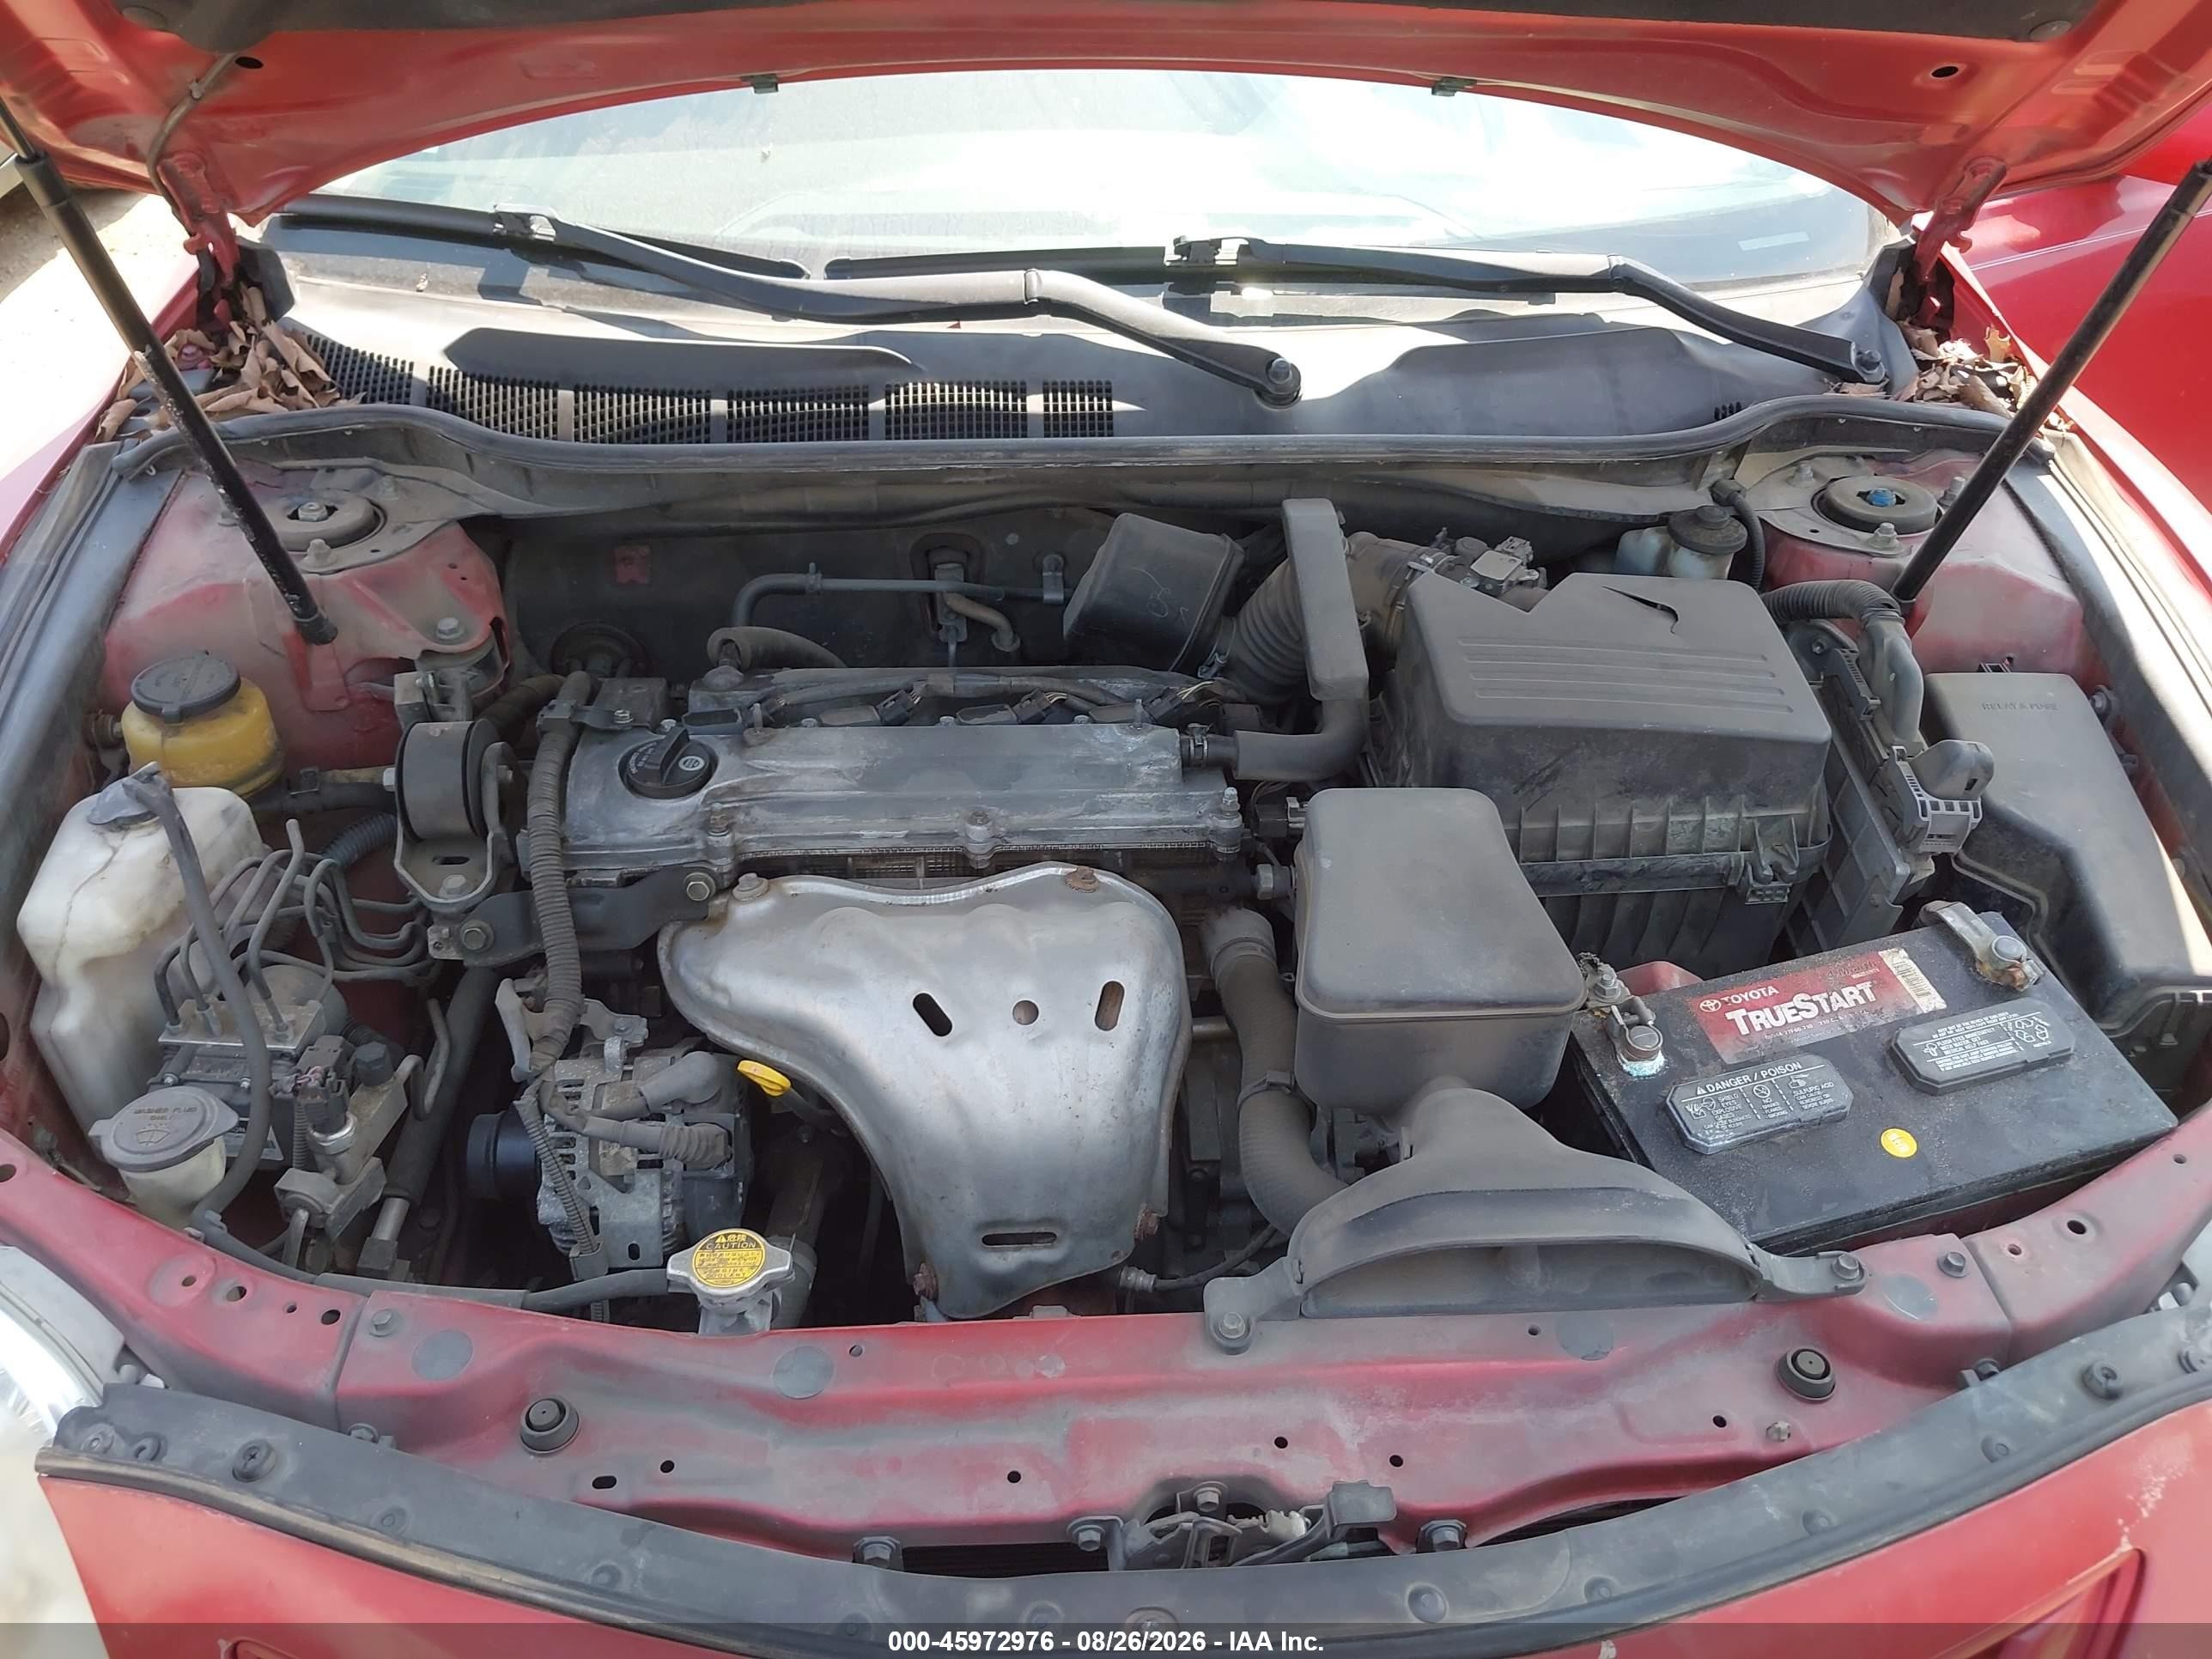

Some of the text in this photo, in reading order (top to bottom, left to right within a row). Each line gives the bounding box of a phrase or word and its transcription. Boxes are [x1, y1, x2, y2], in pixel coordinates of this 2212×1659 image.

[1981, 702, 2016, 712] RELAY
[2028, 702, 2058, 711] FUSE
[1720, 986, 1780, 1006] TOYOTA
[1705, 1074, 1753, 1093] DANGER
[1760, 1061, 1803, 1079] POISON
[1793, 1081, 1834, 1095] SULFURIC ACID
[706, 1241, 757, 1250] CAUTION
